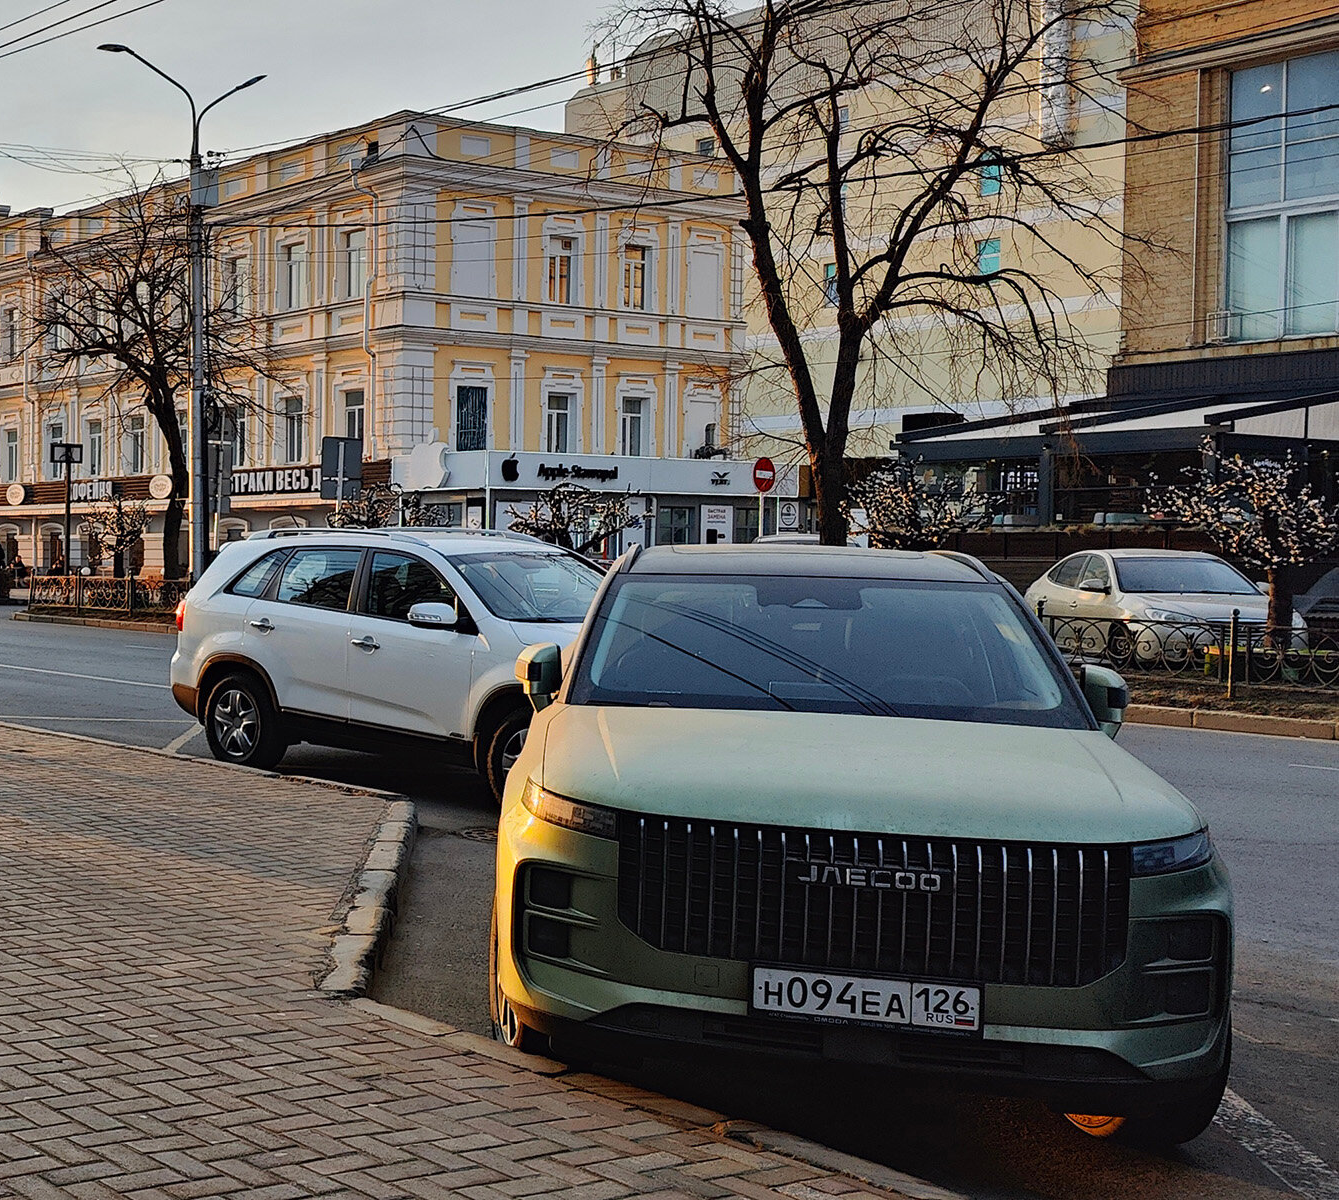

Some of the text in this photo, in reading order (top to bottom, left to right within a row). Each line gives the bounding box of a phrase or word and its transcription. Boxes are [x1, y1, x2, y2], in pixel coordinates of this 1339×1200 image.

[230, 471, 274, 493] ТРАКИ
[275, 469, 309, 491] ВЕСЬ
[797, 865, 941, 892] JAECOO
[914, 987, 970, 1015] 126
[925, 1012, 954, 1024] RUS
